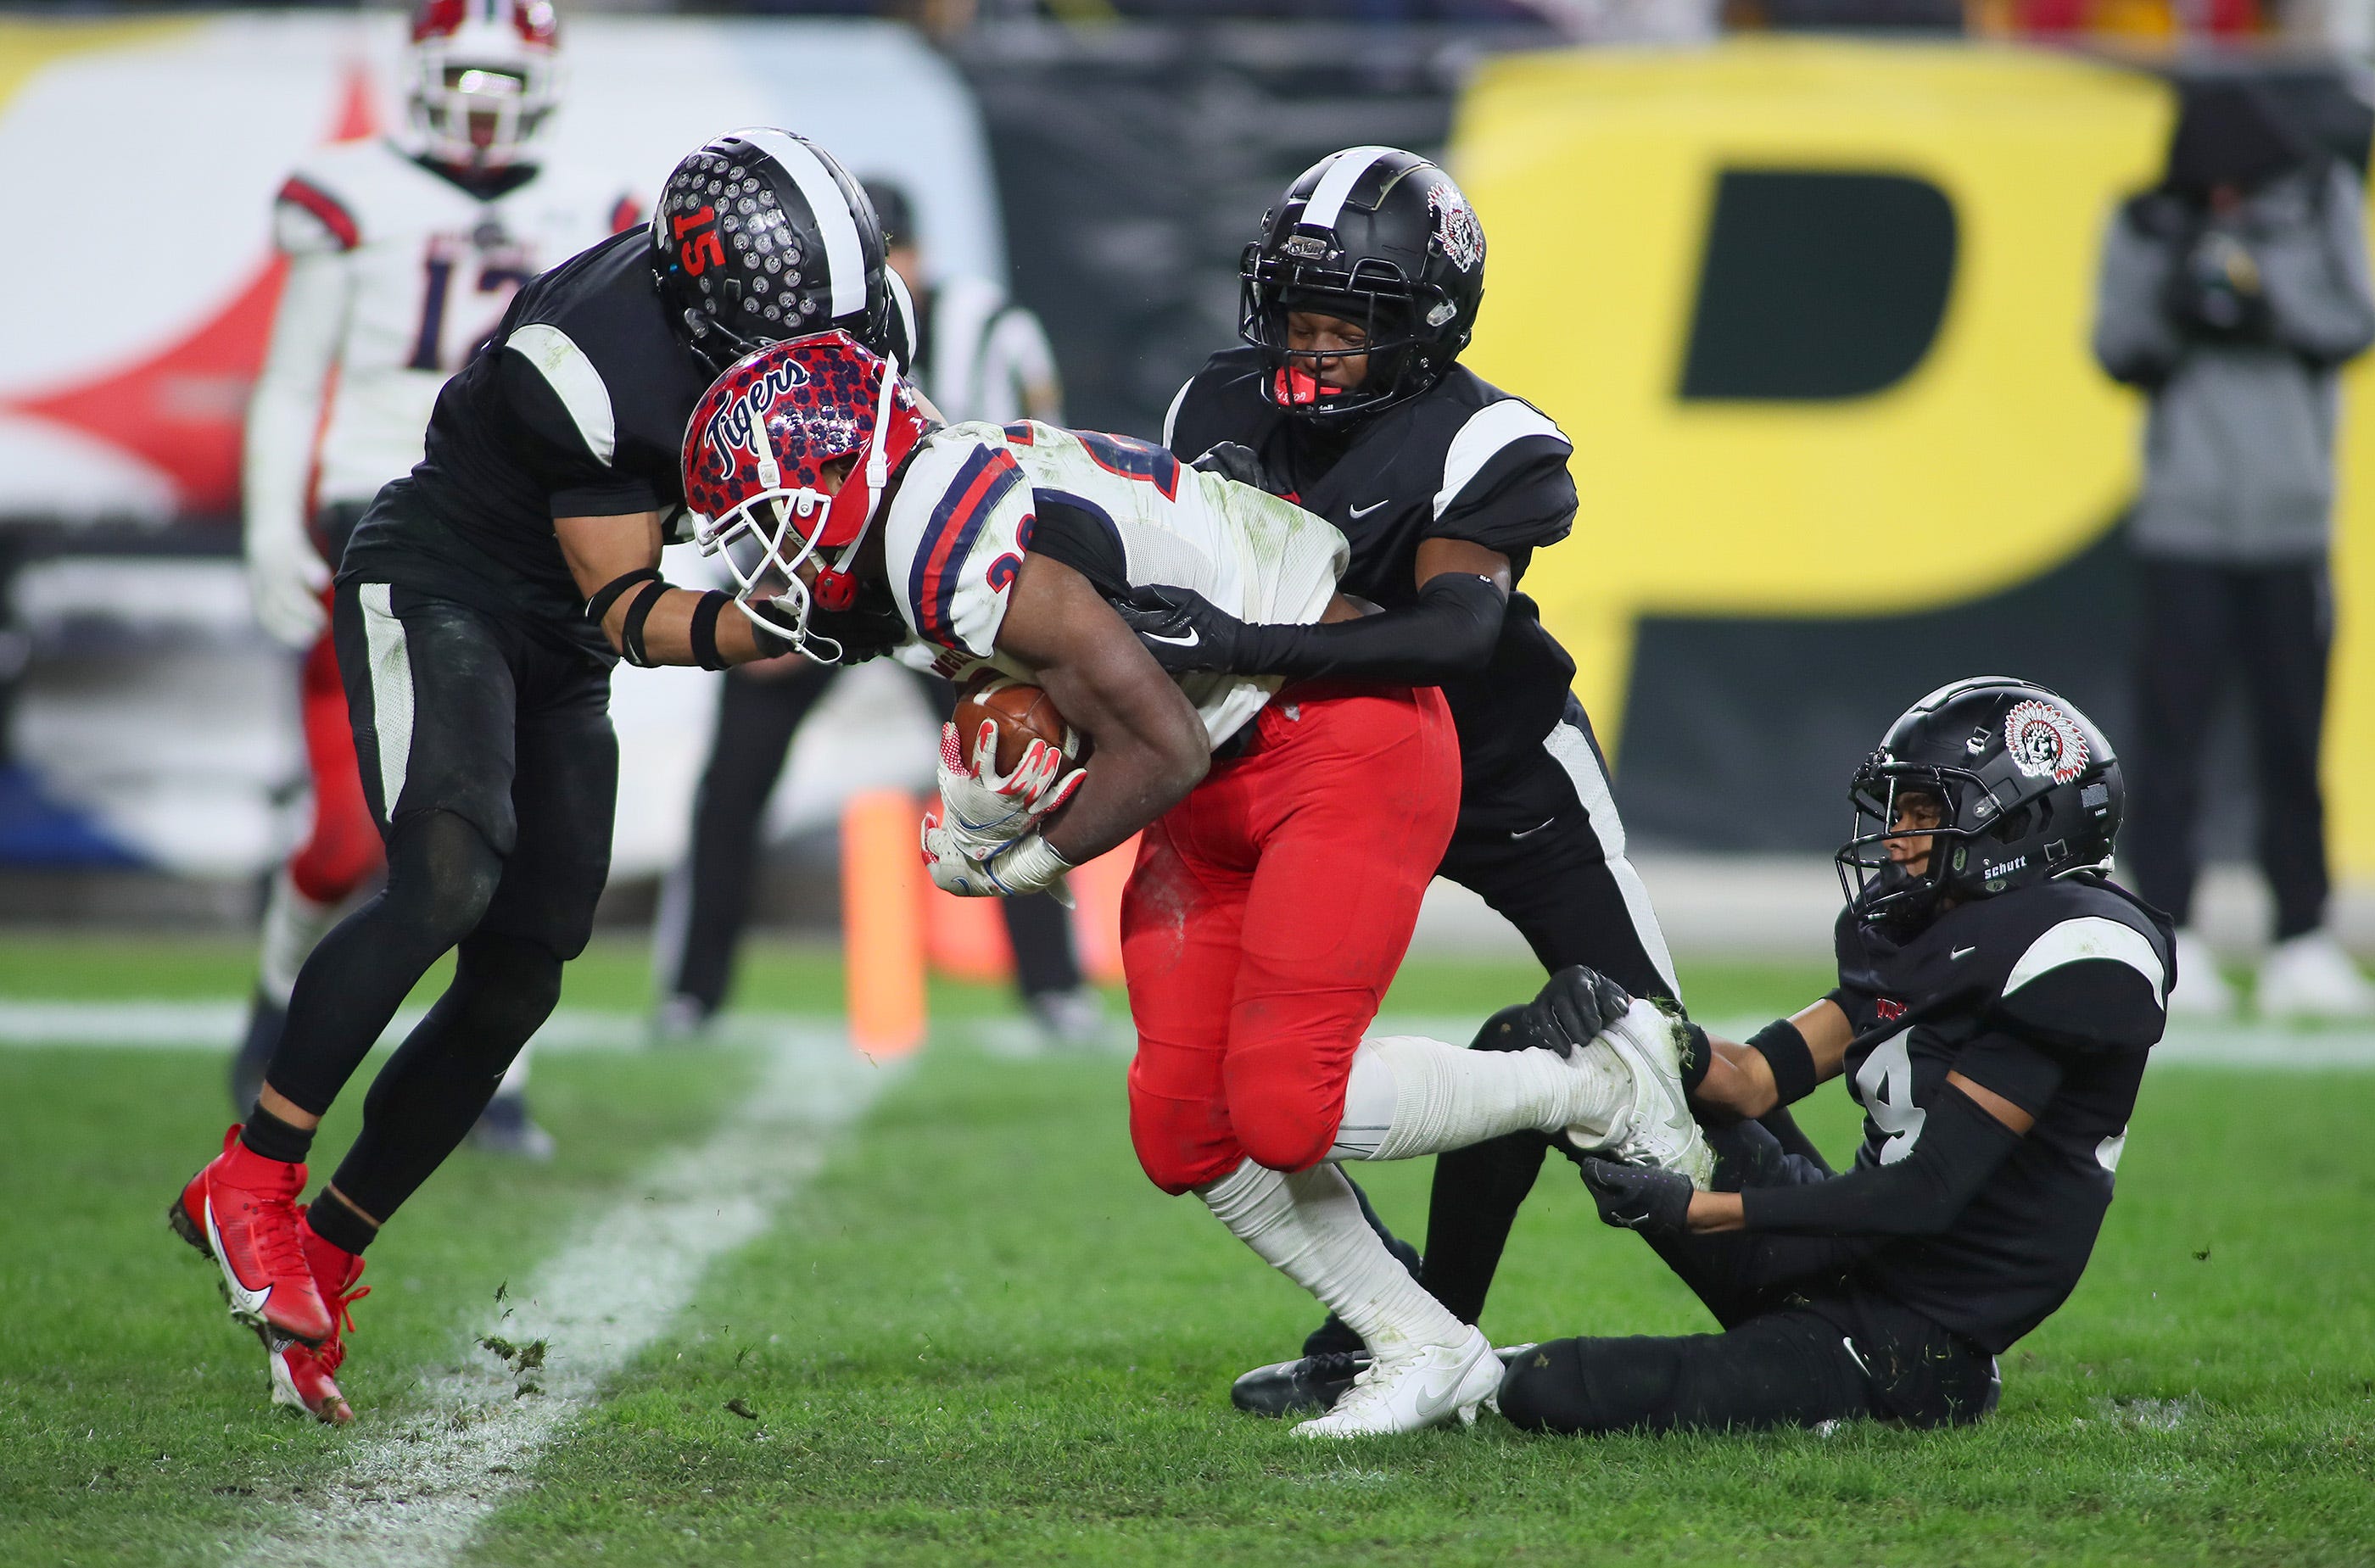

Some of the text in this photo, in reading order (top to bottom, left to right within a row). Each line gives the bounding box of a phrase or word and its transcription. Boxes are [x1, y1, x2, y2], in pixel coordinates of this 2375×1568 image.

[673, 204, 726, 277] 15
[704, 358, 811, 481] Tigers
[1983, 854, 2028, 880] schutt
